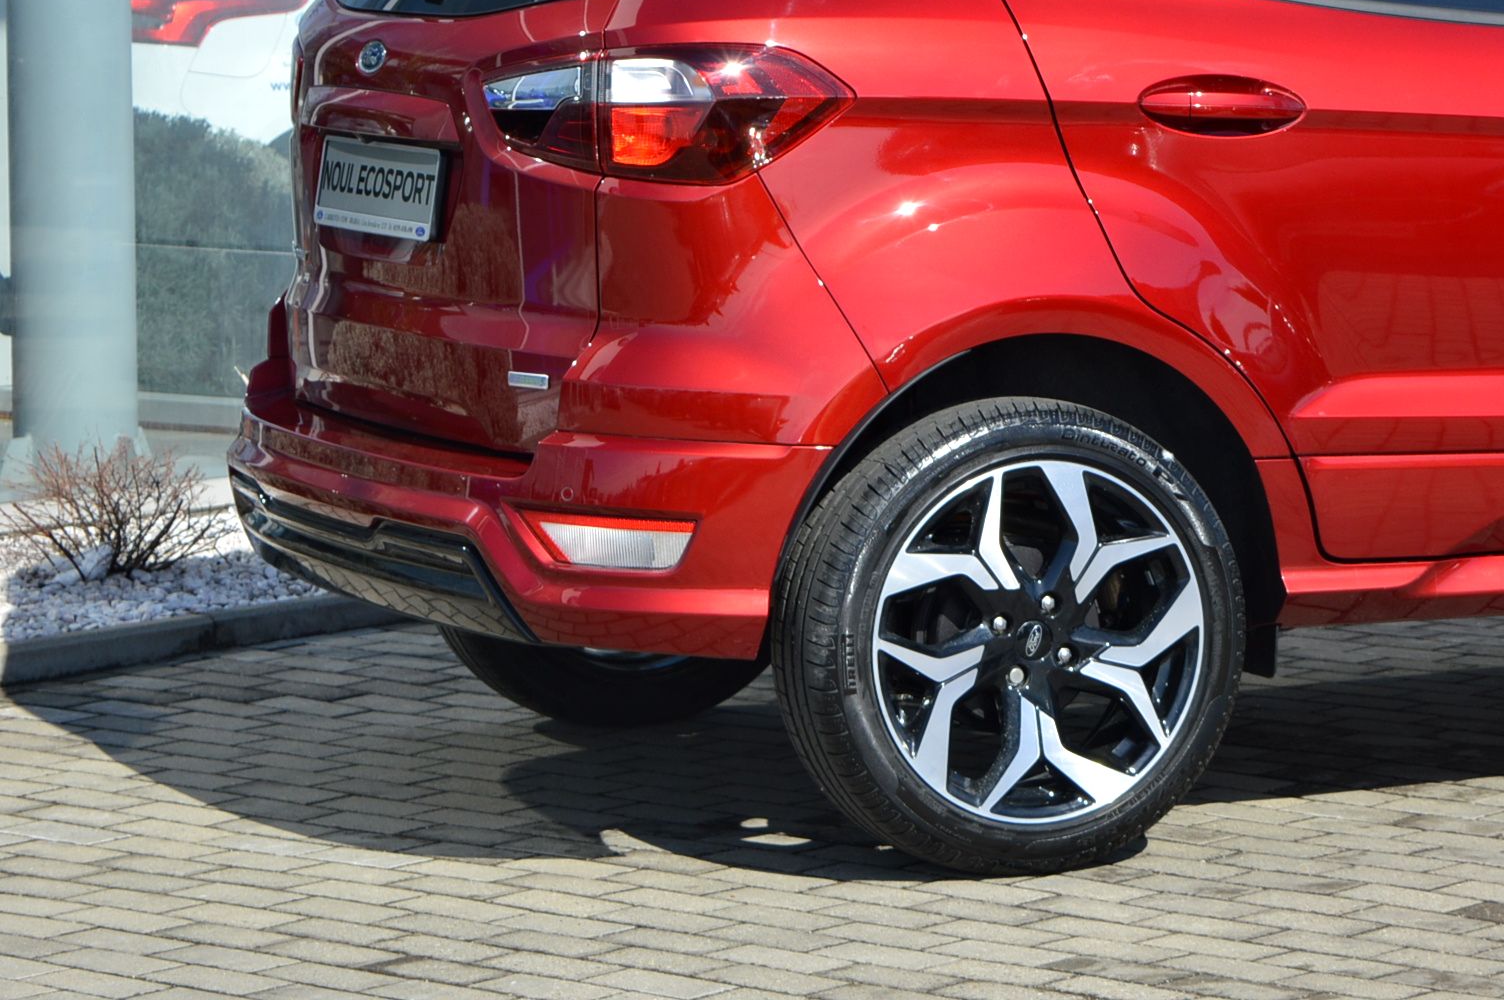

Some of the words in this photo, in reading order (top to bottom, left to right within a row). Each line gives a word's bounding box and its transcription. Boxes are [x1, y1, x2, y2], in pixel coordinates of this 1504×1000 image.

[323, 160, 354, 193] NOUL
[356, 164, 436, 205] ECOSPORT
[841, 633, 858, 696] PIRELLI
